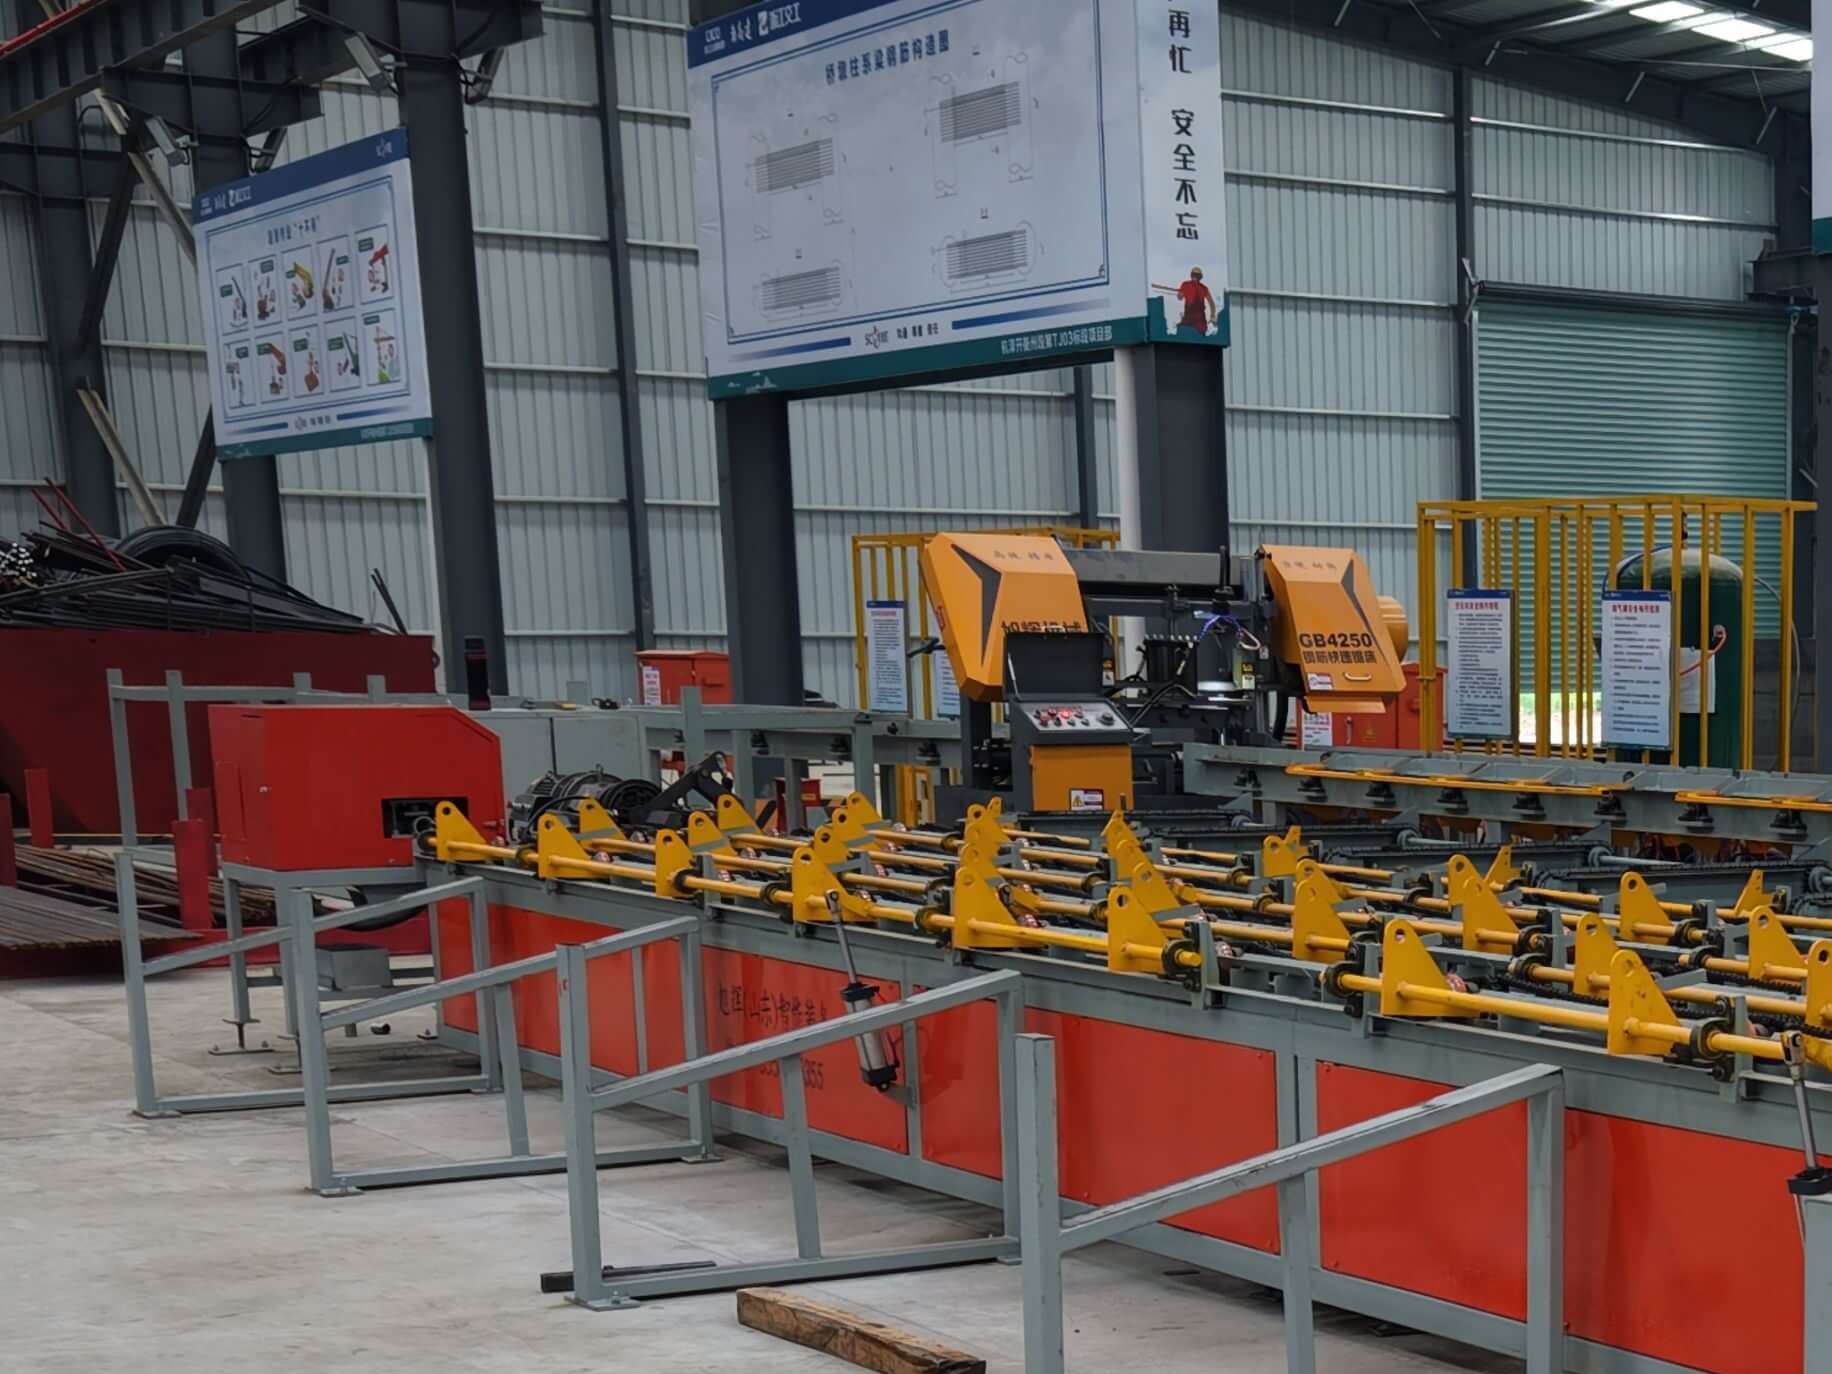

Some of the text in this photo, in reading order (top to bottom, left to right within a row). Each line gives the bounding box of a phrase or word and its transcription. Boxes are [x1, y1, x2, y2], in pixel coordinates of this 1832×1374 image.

[1167, 9, 1199, 240] 再忙 安全不忘
[1299, 632, 1373, 648] GB4250
